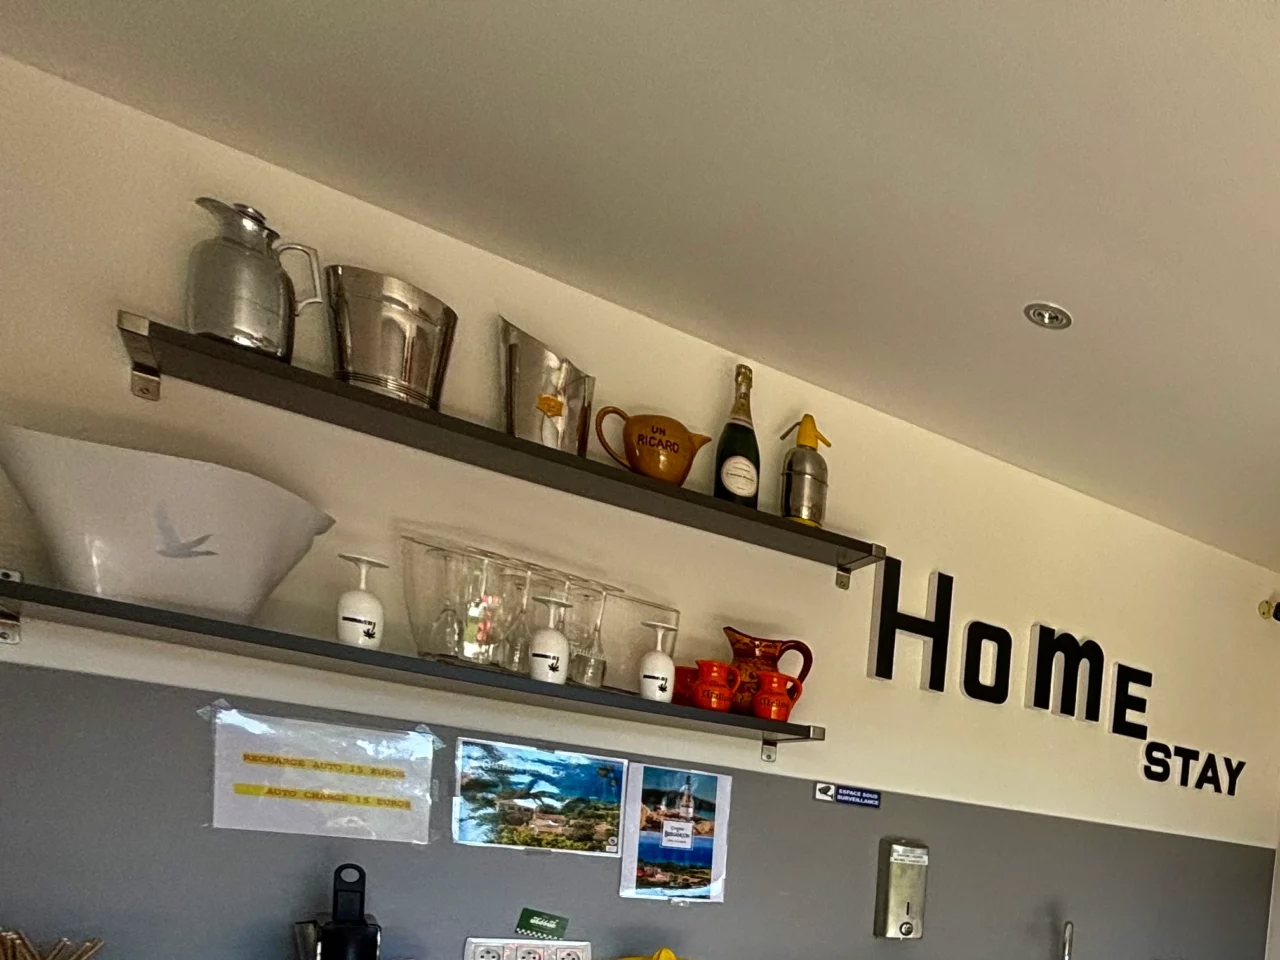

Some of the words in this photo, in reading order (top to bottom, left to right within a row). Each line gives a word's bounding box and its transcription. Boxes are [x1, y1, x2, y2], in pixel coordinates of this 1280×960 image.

[651, 425, 667, 436] UN
[637, 433, 680, 454] RICARD
[243, 752, 306, 769] RECHARGE
[313, 760, 342, 771] AUTO
[350, 764, 364, 774] 15
[370, 767, 406, 780] EUROS
[1143, 741, 1246, 796] STAY
[265, 786, 297, 798] AUTO
[304, 791, 349, 804] CHARGE
[354, 795, 369, 805] 15
[376, 797, 412, 810] EUROS
[836, 794, 879, 806] SURVEILLANCE
[838, 788, 861, 797] ESPACE
[862, 792, 879, 800] SOUS
